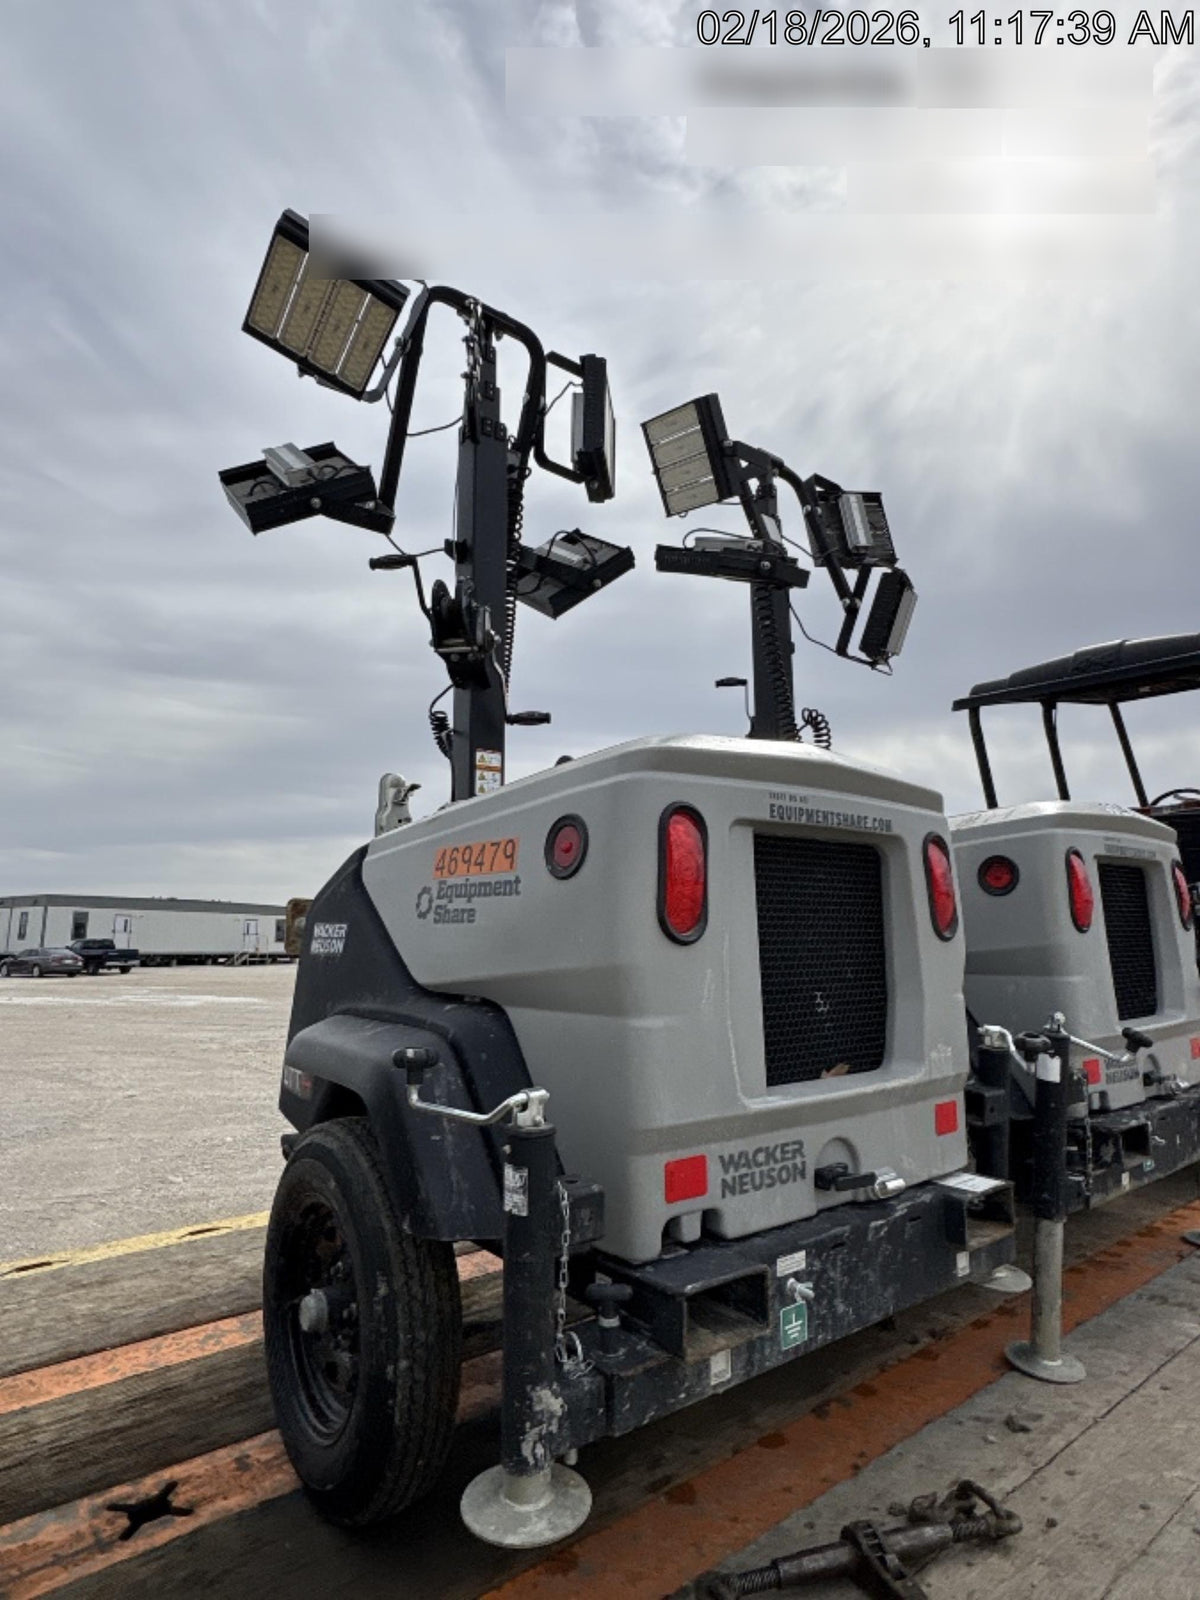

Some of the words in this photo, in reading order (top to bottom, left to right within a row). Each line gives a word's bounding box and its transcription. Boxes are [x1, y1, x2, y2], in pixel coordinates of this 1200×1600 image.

[769, 803, 893, 832] EQUIPMENTSHARE.COM
[435, 838, 516, 876] 469479
[436, 875, 521, 903] Equipment
[433, 904, 476, 924] Share
[718, 1139, 806, 1175] WACKER
[721, 1160, 806, 1199] NEUSON
